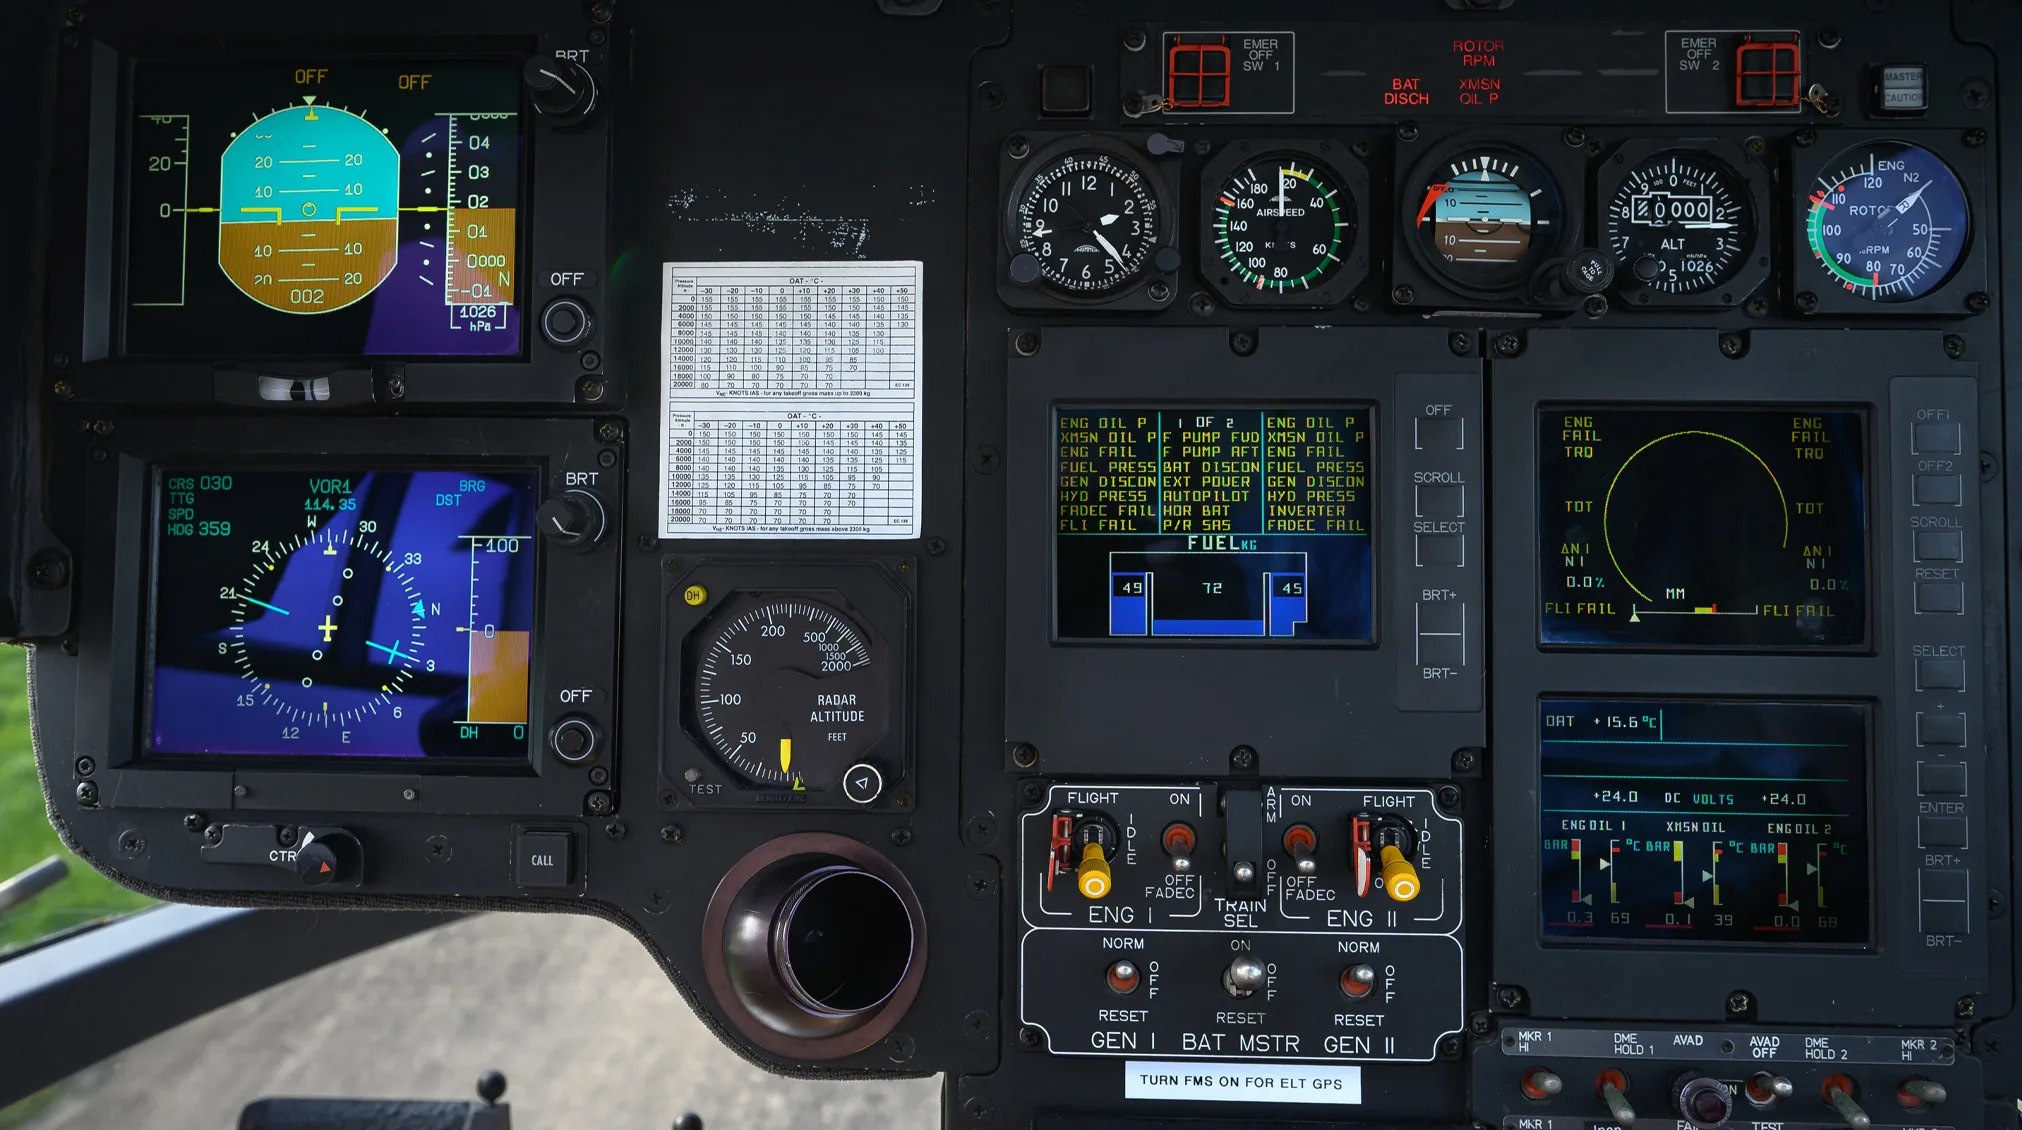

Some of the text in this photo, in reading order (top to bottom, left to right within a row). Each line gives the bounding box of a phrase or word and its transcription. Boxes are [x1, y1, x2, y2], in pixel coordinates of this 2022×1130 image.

[1244, 39, 1277, 49] EMER
[1454, 40, 1504, 52] ROTOR
[1682, 38, 1716, 48] EMER
[1249, 50, 1273, 60] OFF
[1687, 49, 1711, 59] OFF
[1244, 61, 1278, 71] SW 1
[1464, 55, 1494, 66] RPM
[1680, 60, 1719, 70] SW 2
[296, 69, 328, 84] OFF
[399, 75, 431, 90] OFF
[1393, 78, 1419, 90] BAT
[1460, 78, 1500, 90] XMSN
[1385, 93, 1428, 104] DISCH
[1460, 93, 1498, 104] OIL P
[149, 157, 170, 171] 20
[1879, 161, 1904, 171] ENG
[1082, 176, 1096, 190] 12
[1865, 177, 1882, 188] 120
[1904, 173, 1919, 182] N2
[1251, 184, 1267, 194] 180
[1238, 198, 1254, 209] 160
[1832, 194, 1845, 204] 110
[1044, 198, 1058, 212] 10
[1231, 221, 1247, 231] 140
[1823, 225, 1841, 235] 100
[1913, 224, 1927, 235] 50
[1236, 242, 1253, 252] 120
[1313, 244, 1326, 254] 60
[1661, 239, 1685, 249] ALT
[1866, 246, 1889, 254] RPM
[1907, 247, 1921, 258] 60
[1249, 257, 1265, 268] 100
[1837, 253, 1851, 264] 90
[1589, 260, 1602, 275] PULL
[1682, 261, 1713, 272] 1026
[1866, 261, 1881, 271] 80
[1890, 264, 1904, 275] 70
[1274, 267, 1287, 277] 80
[1582, 267, 1595, 281] CAGE
[551, 273, 584, 285] OFF
[291, 289, 323, 303] 002
[460, 306, 496, 317] 1026
[678, 304, 696, 312] 2000
[470, 321, 491, 331] hPa
[1426, 405, 1452, 415] OFF
[1565, 417, 1592, 427] ENG
[1563, 430, 1601, 441] FAIL
[1565, 447, 1592, 458] TRQ
[1061, 462, 1156, 472] FUEL PRESS
[1164, 462, 1259, 472] BAT DISCON
[1919, 461, 1952, 471] OFF2
[169, 476, 232, 490] CRS 030
[567, 472, 598, 485] BRT
[1061, 476, 1156, 487] GEN DISCON
[1164, 476, 1249, 487] EXT POWER
[1415, 472, 1465, 483] SCROLL
[310, 480, 352, 494] VOR1
[460, 480, 485, 492] BRG
[171, 492, 194, 504] TTG
[436, 494, 462, 506] DST
[1061, 491, 1146, 501] HYD PRESS
[1164, 491, 1249, 501] AUTOPILOT
[304, 498, 356, 511] 114.35
[1566, 501, 1592, 512] TOT
[169, 508, 194, 520] SPD
[1061, 505, 1155, 516] FADEC FAIL
[1164, 505, 1229, 516] HOR BAT
[1270, 505, 1344, 516] INVERTER
[360, 521, 376, 532] 30
[1061, 520, 1136, 530] FLI FAIL
[1414, 522, 1465, 532] SELECT
[1911, 517, 1962, 528] SCROLL
[168, 522, 230, 536] HDG 359
[252, 541, 269, 553] 24
[486, 539, 519, 553] 100
[1188, 535, 1256, 550] FUEL KG
[405, 553, 421, 564] 33
[1916, 568, 1959, 579] RESET
[1123, 583, 1141, 593] 49
[1203, 583, 1221, 593] 72
[1283, 583, 1301, 593] 45
[1667, 588, 1684, 599] MM
[687, 591, 699, 600] DH
[1423, 590, 1456, 600] BRT+
[761, 626, 785, 636] 200
[804, 632, 825, 642] 500
[819, 643, 839, 651] 1000
[1913, 645, 1965, 656] SELECT
[731, 654, 751, 665] 150
[826, 652, 846, 660] 1500
[822, 661, 851, 671] 2000
[1424, 668, 1457, 678] BRT-
[561, 690, 592, 702] OFF
[721, 694, 741, 705] 100
[818, 695, 855, 705] RADAR
[811, 711, 864, 722] ALTITUDE
[1547, 716, 1574, 726] OAT
[461, 726, 478, 738] DH
[741, 732, 756, 743] 50
[829, 733, 846, 741] FEET
[689, 785, 722, 794] TEST
[1068, 792, 1119, 803] FLIGHT
[1364, 796, 1415, 807] FLIGHT
[1594, 791, 1733, 804] +24.0 DC VOLTS
[1920, 802, 1964, 813] ENTER
[532, 855, 553, 866] CALL
[1146, 887, 1194, 898] FADEC
[1286, 889, 1335, 900] FADEC
[1214, 898, 1266, 912] TRAIN
[1090, 906, 1133, 923] ENG
[1224, 914, 1258, 927] SEL
[1104, 938, 1143, 949] NORM
[1339, 942, 1379, 953] NORM
[1100, 1010, 1148, 1021] RESET
[1217, 1012, 1265, 1024] RESET
[1092, 1032, 1136, 1049] GEN
[1519, 1031, 1551, 1041] MKR 1
[1615, 1033, 1637, 1043] DME
[1673, 1035, 1703, 1045] AVAD
[1750, 1036, 1779, 1047] AVAD
[1183, 1033, 1299, 1052] BAT MSTR
[1325, 1036, 1369, 1053] GEN
[1806, 1038, 1828, 1048] DME
[1902, 1040, 1924, 1049] MKR
[1615, 1044, 1653, 1055] HOLD 1
[1753, 1048, 1777, 1058] OFF
[1806, 1049, 1835, 1059] HOLD
[1140, 1075, 1342, 1090] TURN FMS ON FOR ELT GPS
